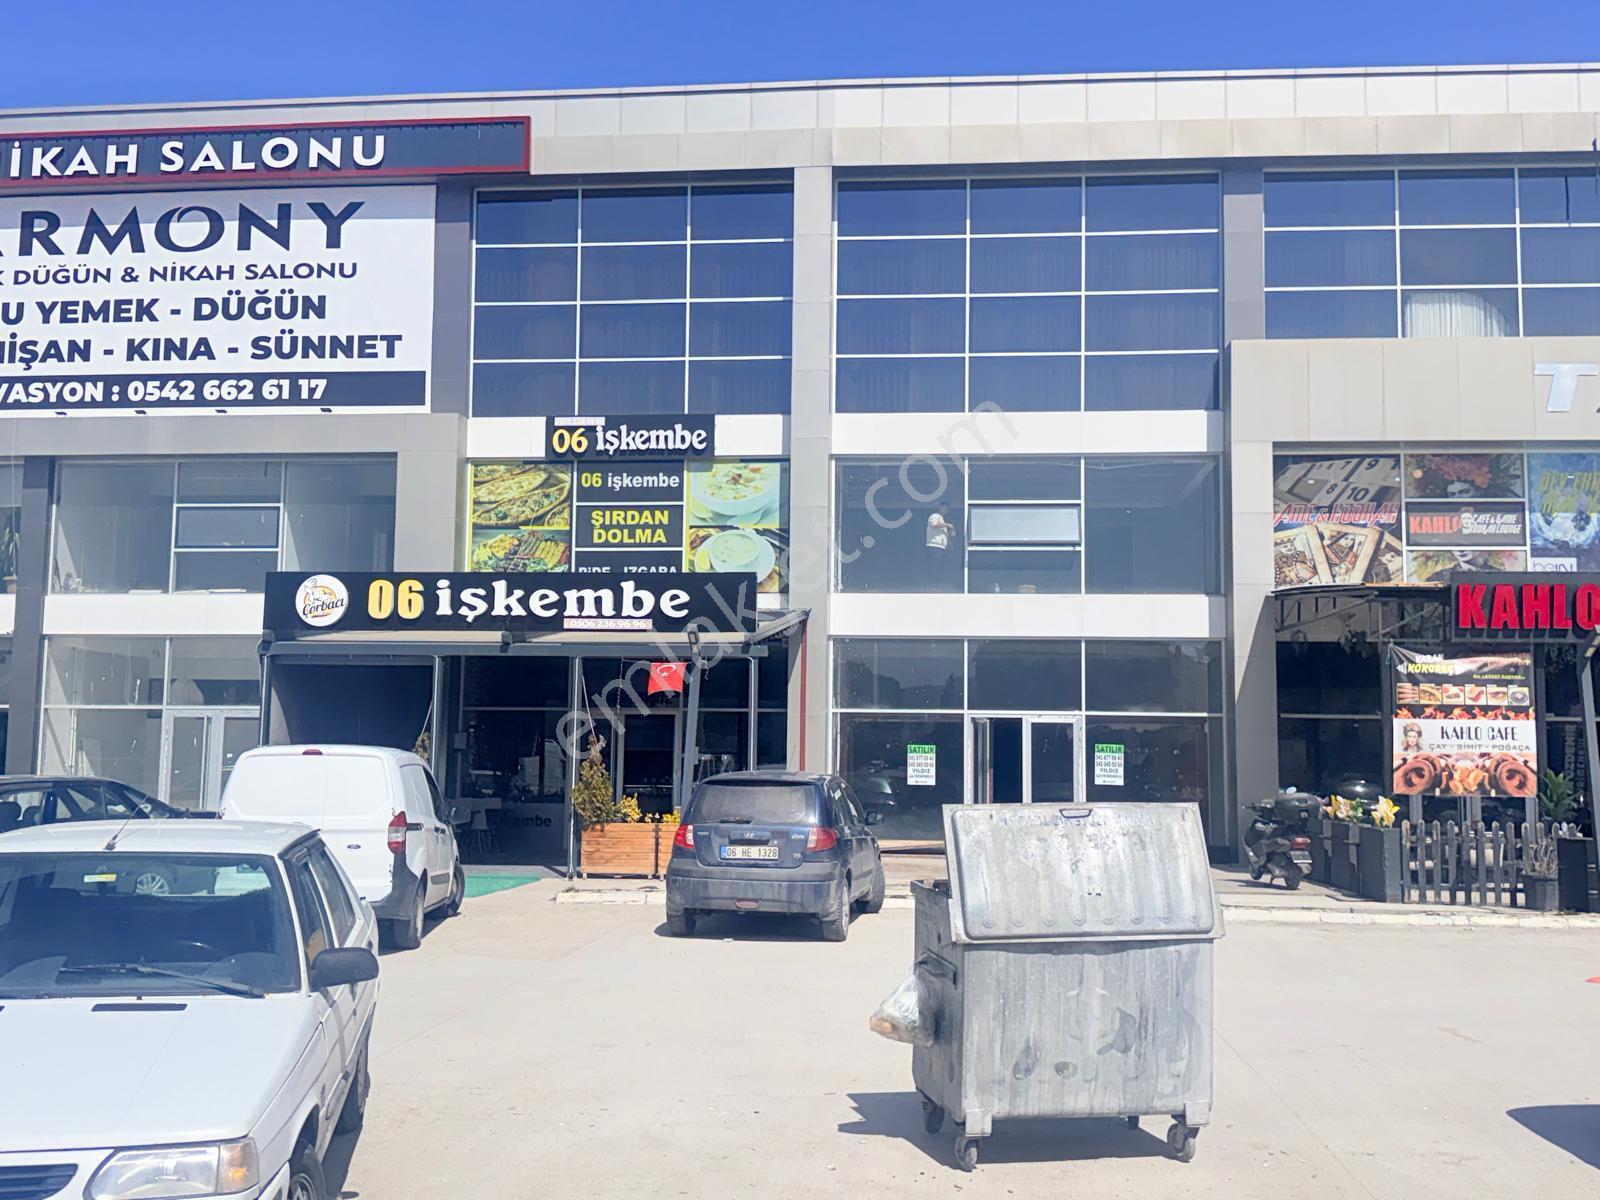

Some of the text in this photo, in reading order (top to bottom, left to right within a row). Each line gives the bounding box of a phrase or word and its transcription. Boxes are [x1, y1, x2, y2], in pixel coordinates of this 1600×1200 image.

[10, 135, 385, 178] İKAH SALONU
[0, 201, 365, 257] RMONY
[13, 263, 111, 285] DÜĞÜN
[121, 266, 139, 283] &
[149, 261, 235, 282] NİKAH
[245, 262, 358, 281] SALONU
[36, 298, 160, 324] YEMEK
[193, 288, 327, 322] DÜĞÜN
[126, 337, 216, 362] KINA
[250, 328, 403, 360] SÜNNET
[127, 380, 196, 402] 0542
[202, 379, 254, 401] 662
[261, 379, 290, 401] 61
[298, 378, 328, 400] 17
[1534, 363, 1600, 413] T
[552, 423, 708, 456] 06 işkembe
[581, 472, 680, 491] 06 işkembe
[1346, 486, 1370, 502] 10
[591, 510, 669, 528] ŞIRDAN
[1273, 502, 1316, 527] AME
[592, 528, 667, 544] DOLMA
[367, 579, 691, 623] 06 işkembe
[1458, 583, 1600, 630] KAHLO
[1440, 726, 1519, 741] KAHLO CAFE
[909, 746, 935, 754] SATILIK
[1096, 745, 1122, 754] SATILIK
[1429, 743, 1448, 751] ÇAY
[727, 847, 737, 857] 06
[741, 848, 752, 857] HE
[758, 848, 778, 858] 1328
